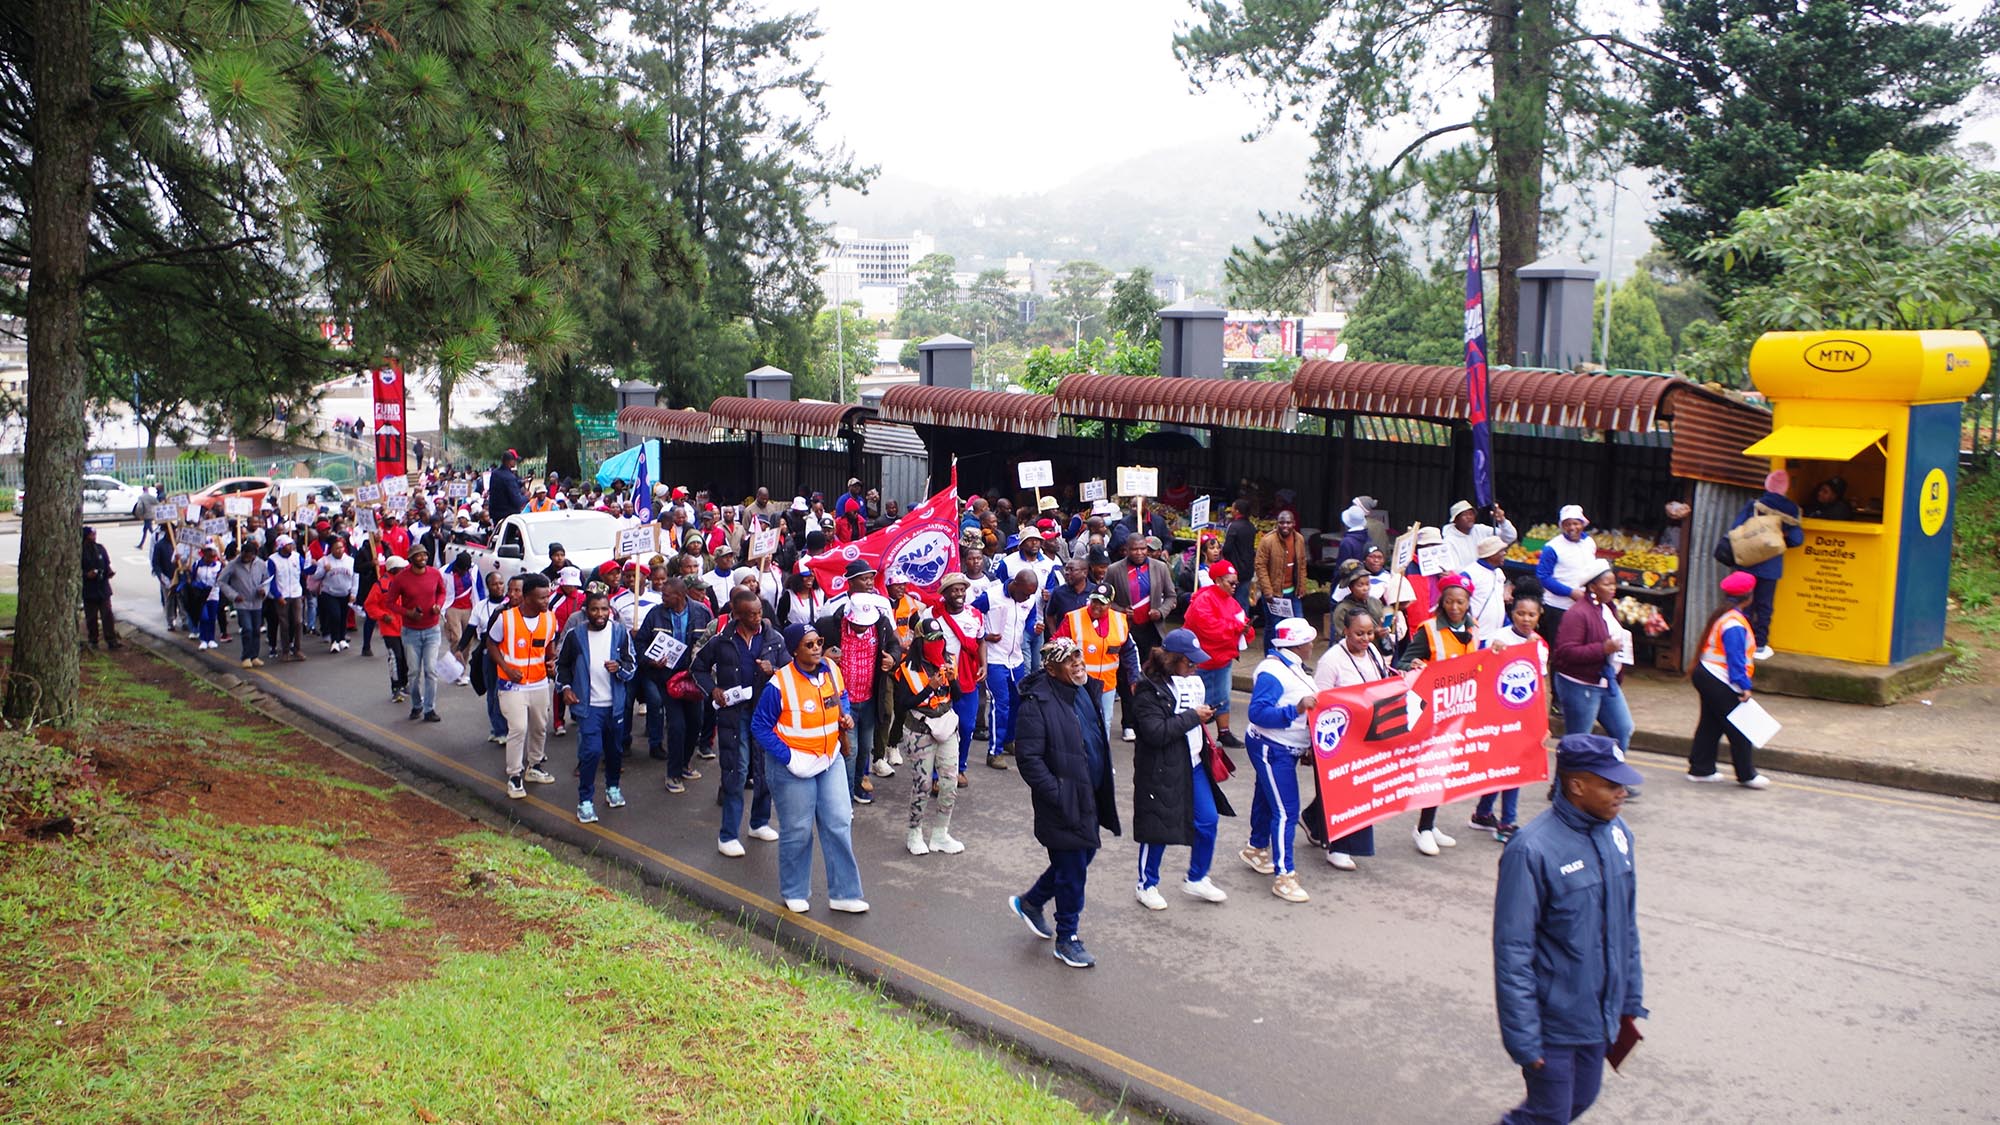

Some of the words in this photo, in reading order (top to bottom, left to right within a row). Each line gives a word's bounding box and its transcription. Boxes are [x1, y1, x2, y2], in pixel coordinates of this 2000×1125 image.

[1819, 349, 1856, 361] MTN
[375, 402, 400, 415] FUND
[622, 541, 633, 552] E
[755, 542, 764, 551] E
[887, 535, 911, 562] NATIONAL
[1815, 536, 1846, 548] Data
[1804, 545, 1856, 560] Bundles
[649, 643, 664, 657] E
[1434, 677, 1446, 689] GO
[1507, 671, 1531, 681] SNAT
[1180, 693, 1190, 709] E
[1432, 679, 1477, 713] FUND
[1321, 716, 1343, 729] SNAT
[1328, 763, 1350, 780] SNAT
[1350, 751, 1392, 771] Advocates
[1394, 747, 1406, 756] for
[1408, 744, 1420, 752] an
[1421, 732, 1465, 749] Inclusive,
[1465, 727, 1500, 739] Quality
[1501, 720, 1521, 733] and
[1352, 762, 1399, 785] Sustainable
[1399, 750, 1449, 768] Education
[1449, 746, 1464, 757] for
[1465, 742, 1477, 754] All
[1477, 741, 1490, 752] by
[1372, 772, 1415, 793] Increasing
[1416, 761, 1469, 778] Budgetary
[1330, 802, 1371, 825] Provisions
[1371, 797, 1384, 808] for
[1384, 794, 1396, 804] an
[1395, 782, 1443, 799] Effective
[1443, 771, 1488, 789] Education
[1487, 766, 1520, 779] Sector
